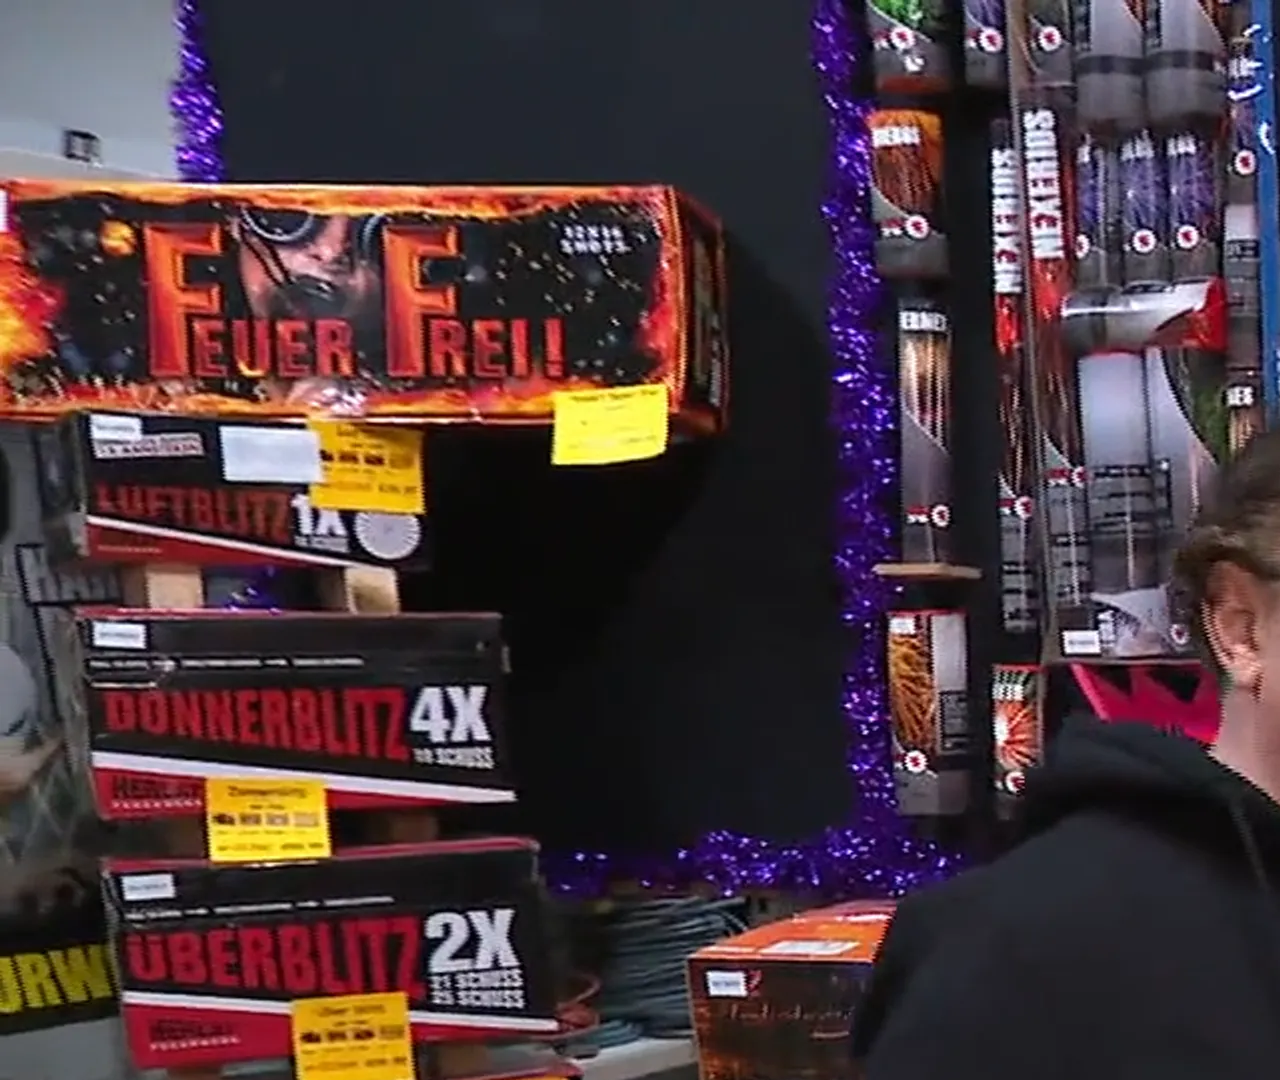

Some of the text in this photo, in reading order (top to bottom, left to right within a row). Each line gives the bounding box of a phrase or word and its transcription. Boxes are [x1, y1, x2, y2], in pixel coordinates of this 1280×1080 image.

[142, 219, 565, 380] FEUER FREI!
[105, 684, 494, 762] DONNERBLITZ 4X
[436, 747, 495, 769] SCHUSS
[125, 907, 521, 1000] ÜBERBLITZ 2X
[455, 968, 524, 990] SCHUSS
[455, 988, 525, 1011] SCHUSS
